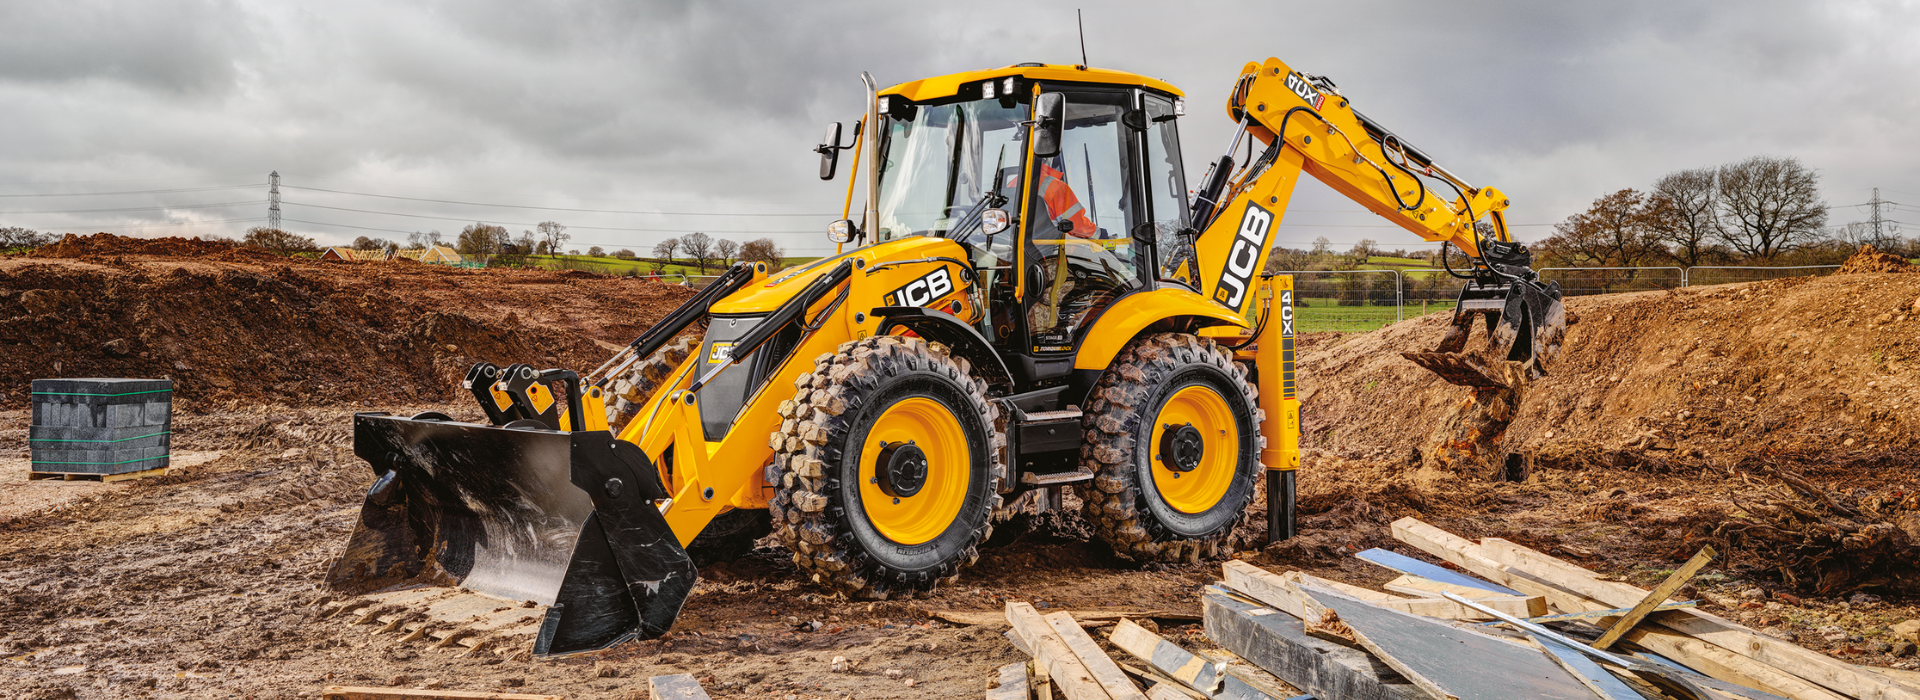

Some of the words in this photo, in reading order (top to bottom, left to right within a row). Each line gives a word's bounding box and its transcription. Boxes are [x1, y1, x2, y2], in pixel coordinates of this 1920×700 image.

[1288, 74, 1318, 106] 4CX
[1222, 205, 1271, 308] JCB
[1281, 291, 1293, 335] 4CX
[711, 345, 733, 360] JC
